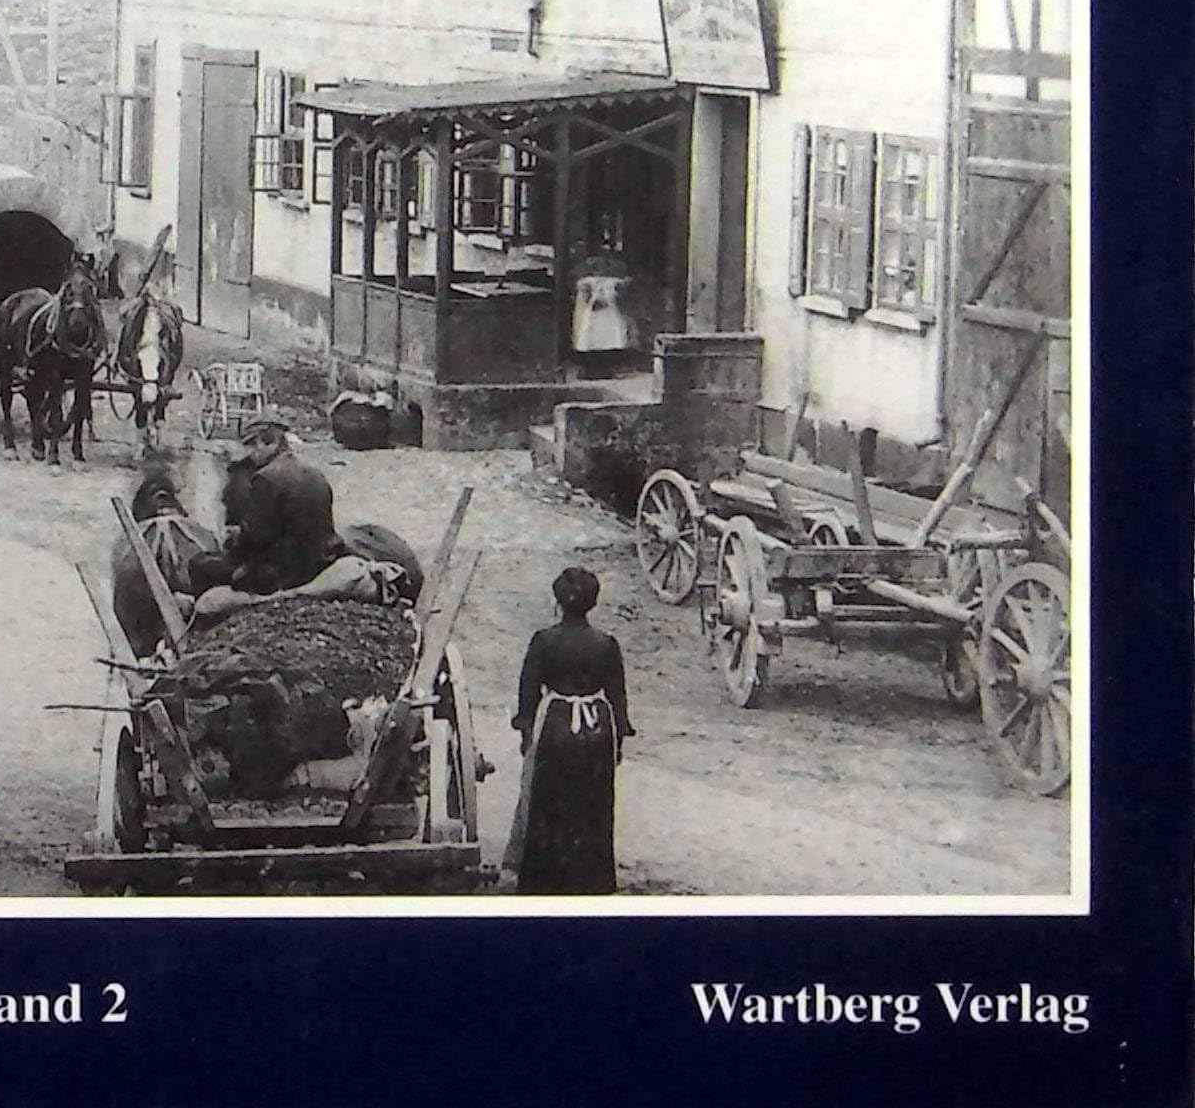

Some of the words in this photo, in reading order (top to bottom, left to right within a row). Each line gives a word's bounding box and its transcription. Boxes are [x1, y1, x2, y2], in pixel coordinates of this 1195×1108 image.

[101, 982, 128, 1023] 2
[690, 983, 921, 1034] Wartberg
[936, 982, 1090, 1034] Verlag
